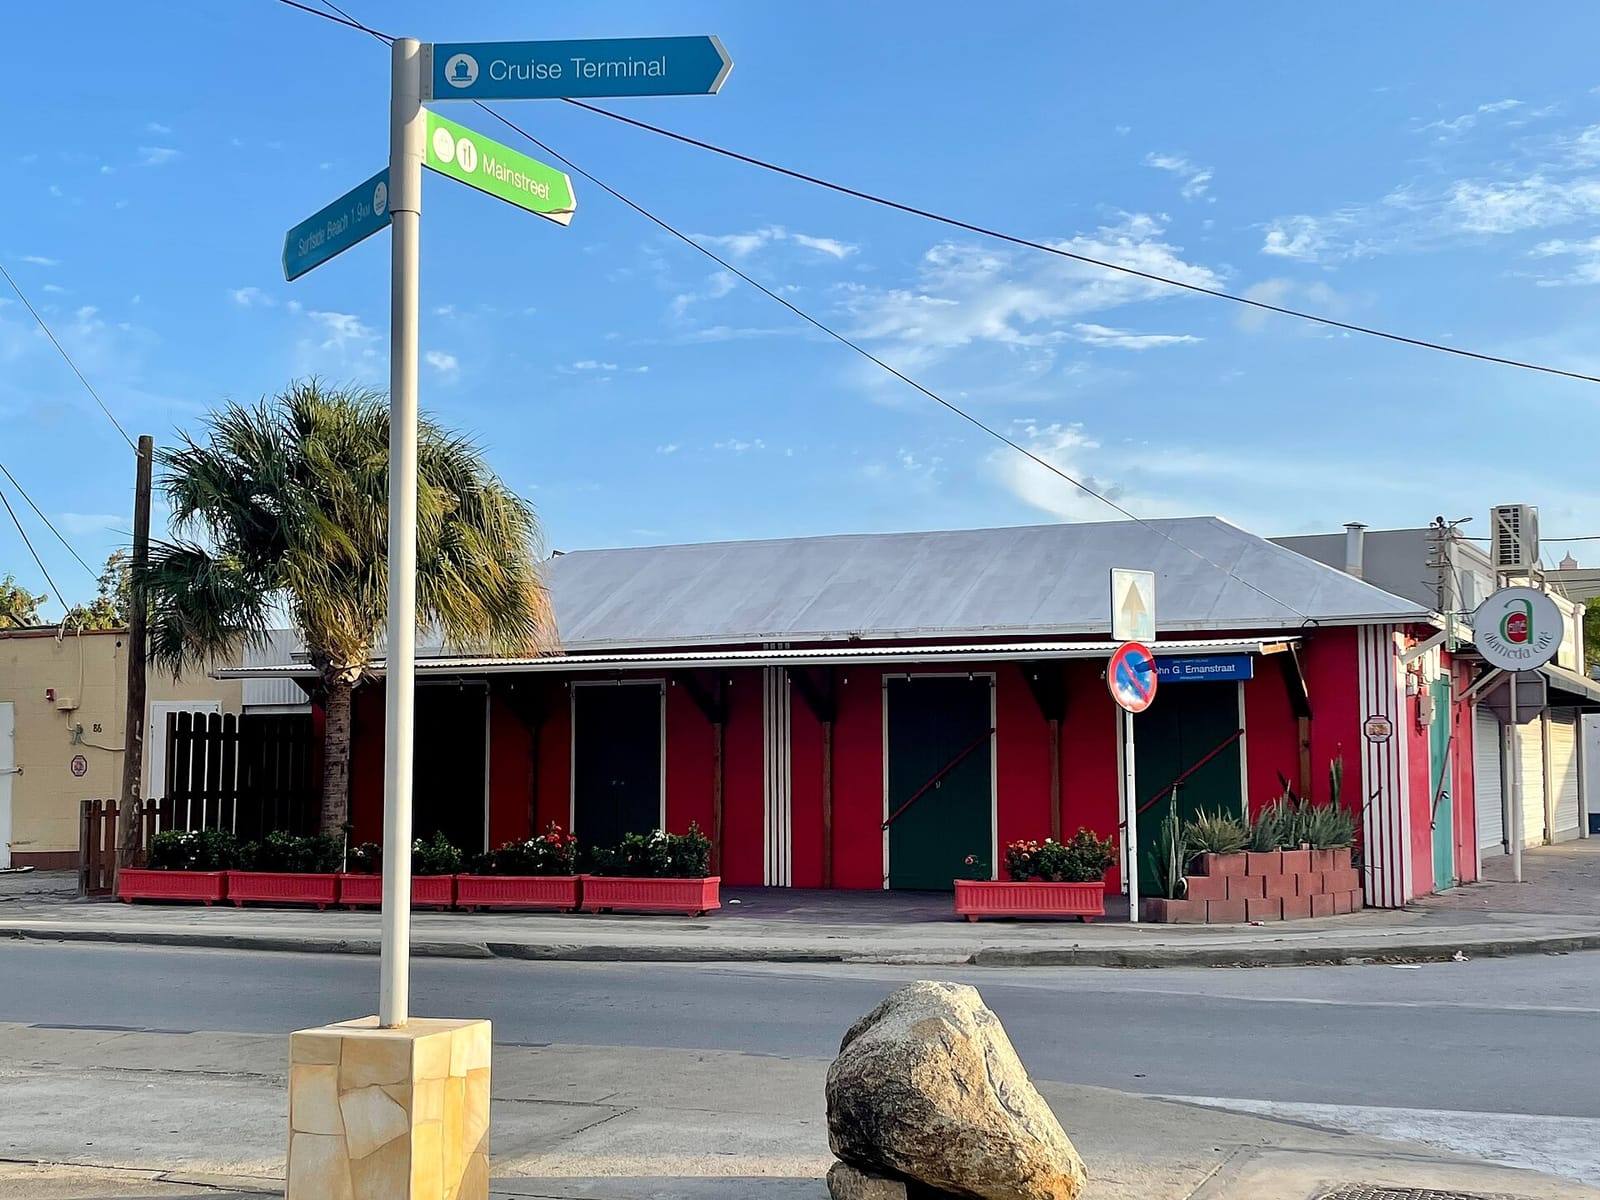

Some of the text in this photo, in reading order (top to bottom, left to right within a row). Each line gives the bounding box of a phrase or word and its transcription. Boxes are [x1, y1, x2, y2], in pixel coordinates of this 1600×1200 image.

[489, 56, 667, 81] Cruise Terminal
[482, 153, 551, 201] Mainstreet
[298, 228, 325, 257] Surfside
[327, 211, 349, 241] Beach
[1185, 664, 1236, 674] Emanstraat
